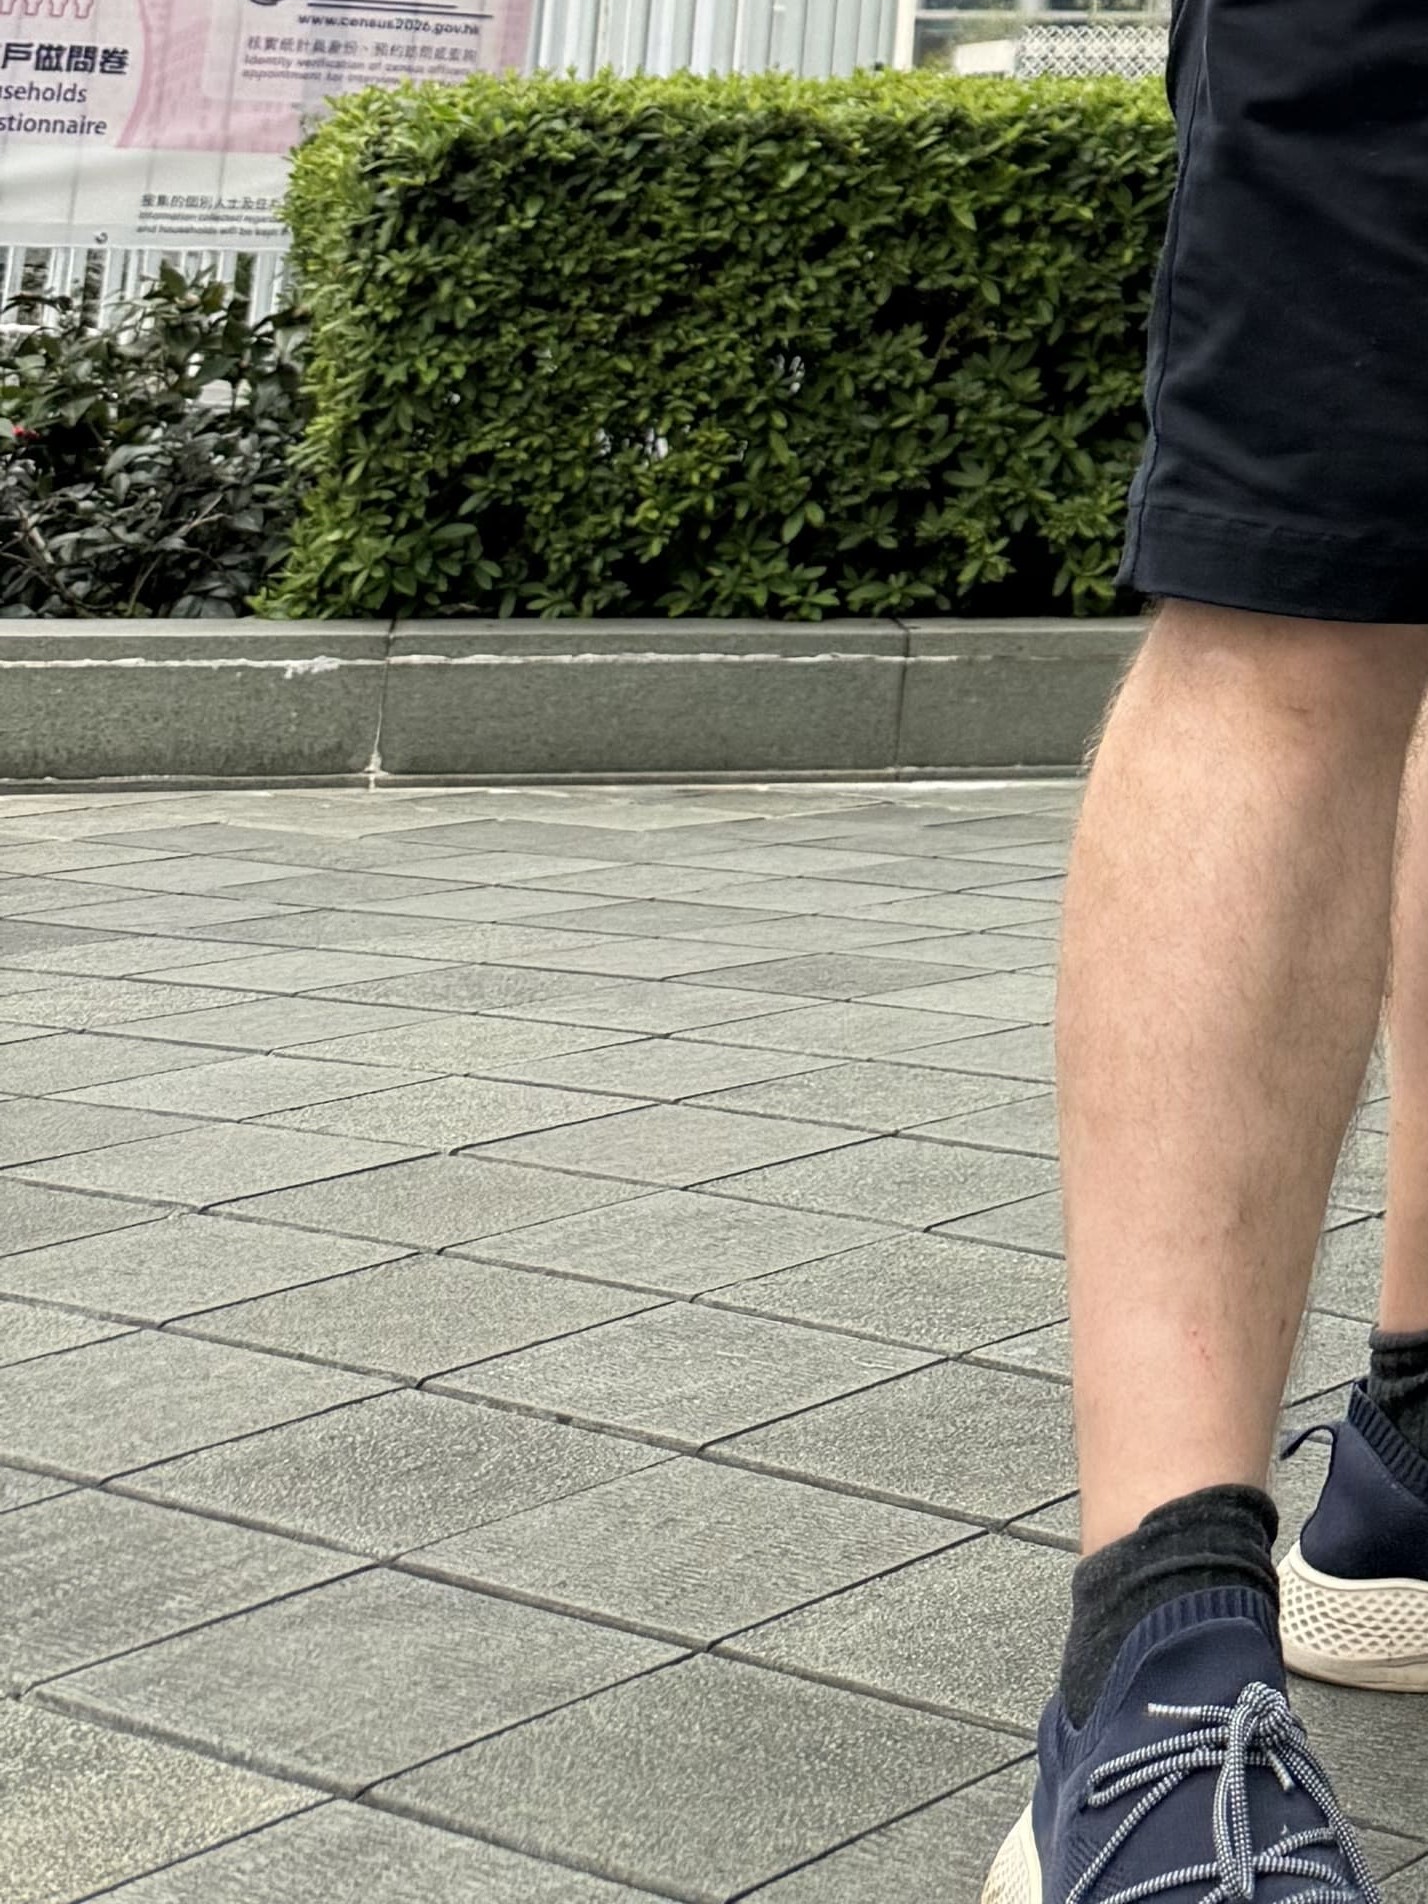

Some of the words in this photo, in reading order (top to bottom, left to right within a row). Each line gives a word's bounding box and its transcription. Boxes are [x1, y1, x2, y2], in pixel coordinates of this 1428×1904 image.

[297, 14, 480, 36] www.census2026.gov.hk
[0, 42, 129, 75] 戶做問卷
